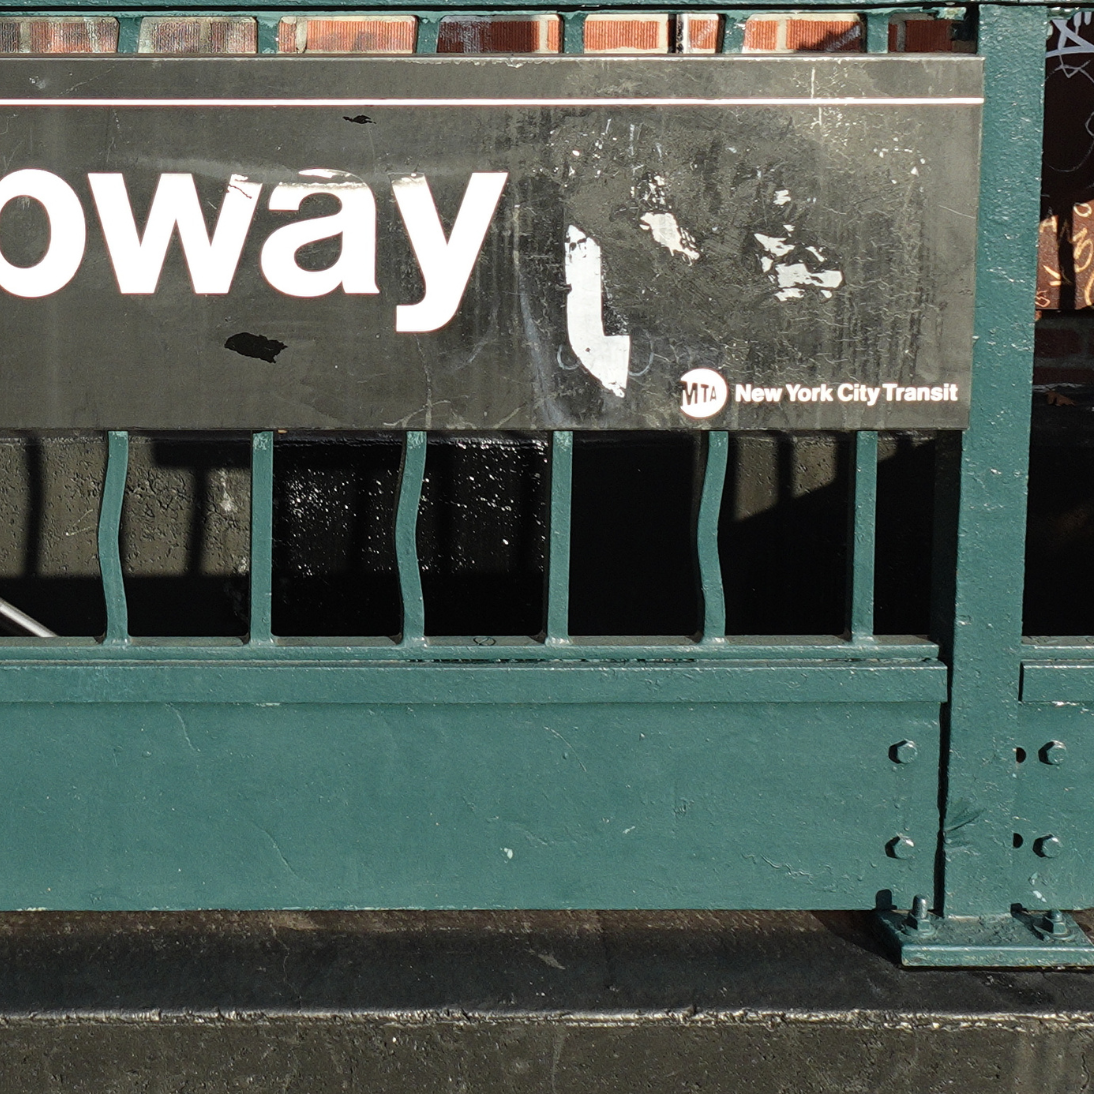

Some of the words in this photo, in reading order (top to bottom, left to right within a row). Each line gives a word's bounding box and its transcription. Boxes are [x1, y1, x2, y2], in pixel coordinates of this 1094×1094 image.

[680, 380, 717, 407] MTA
[735, 384, 784, 402] New
[786, 384, 832, 402] York
[837, 383, 879, 406] City
[882, 382, 959, 402] Transit
